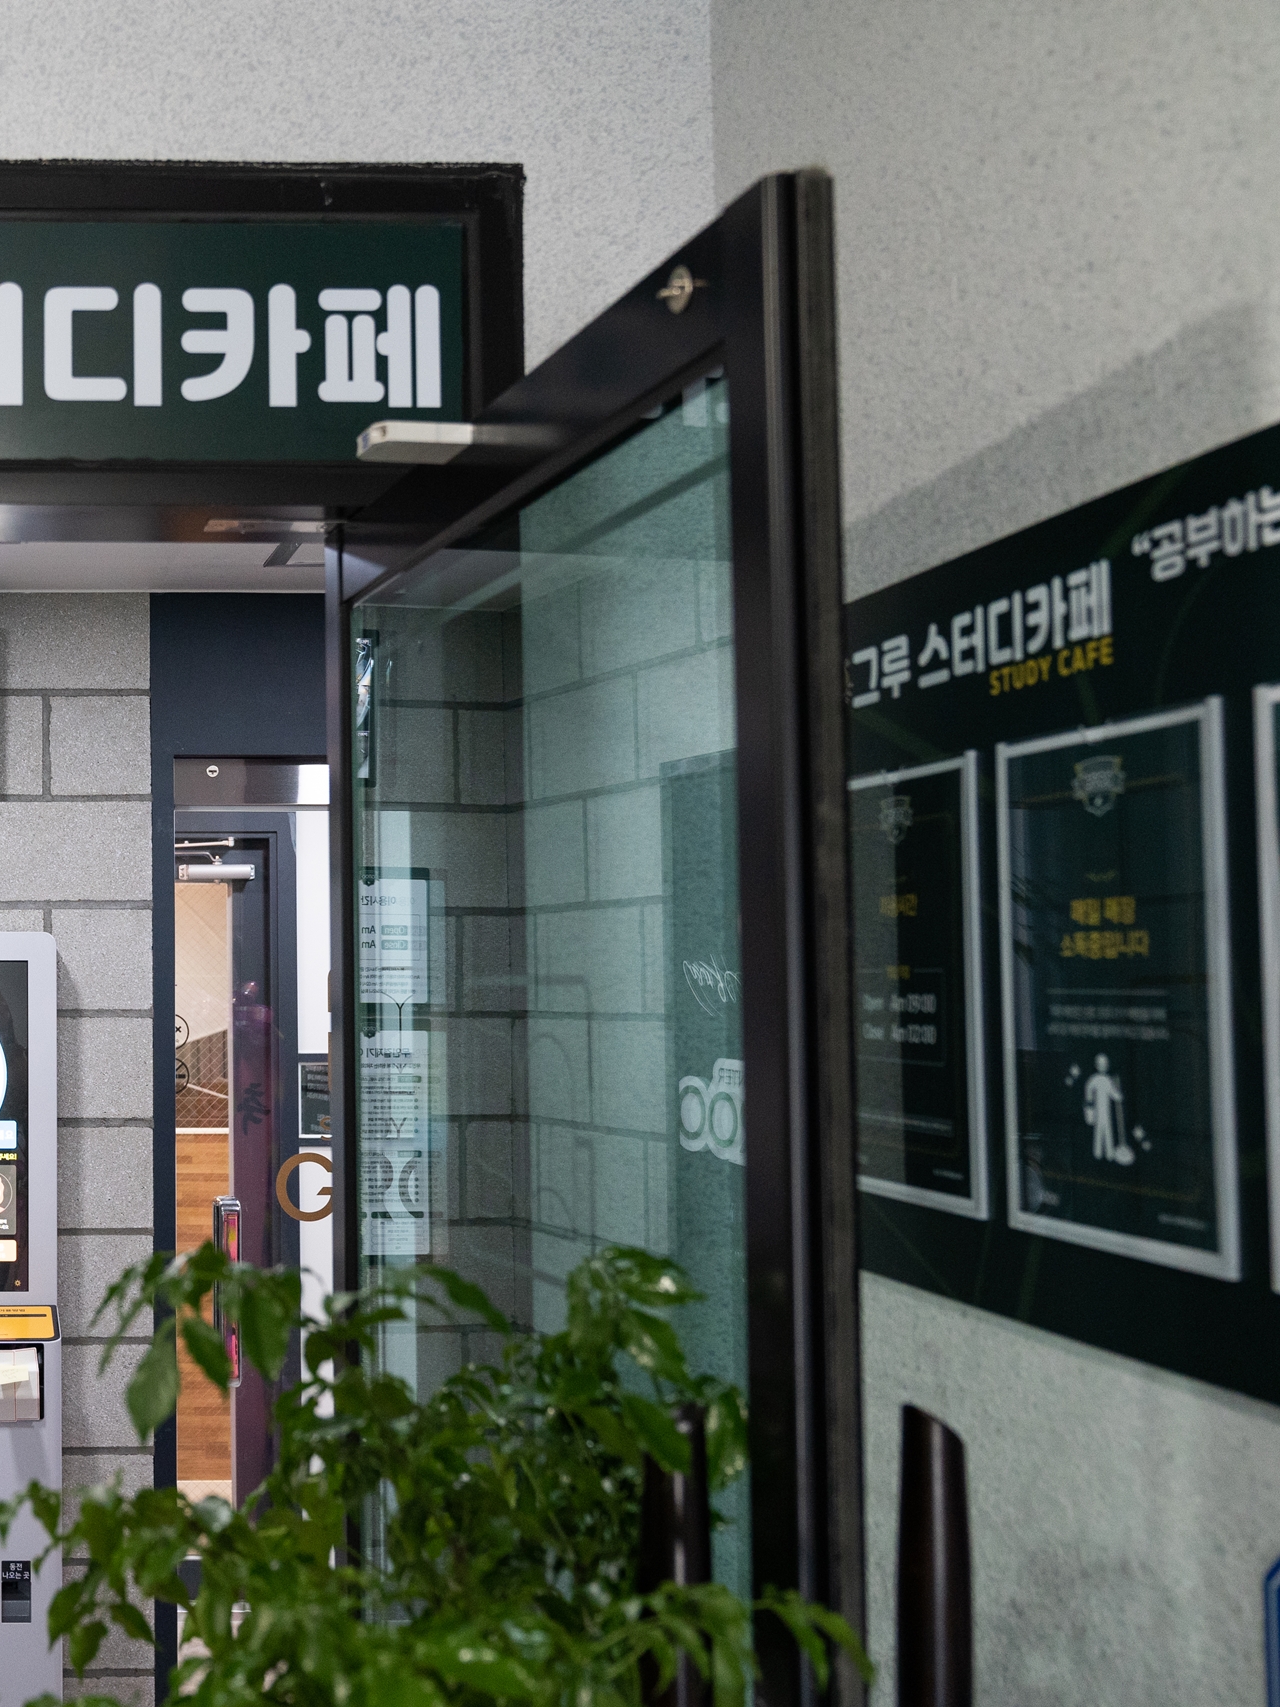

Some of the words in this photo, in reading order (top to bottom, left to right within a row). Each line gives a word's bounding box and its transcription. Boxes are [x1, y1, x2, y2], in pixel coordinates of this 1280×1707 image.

[852, 634, 911, 708] 그루
[918, 558, 1111, 689] 스터디카페
[989, 655, 1051, 696] STUDY
[1057, 636, 1114, 677] CAFE
[2, 1571, 22, 1580] 나오는
[22, 1571, 30, 1580] 곳
[9, 1562, 23, 1571] 동전
